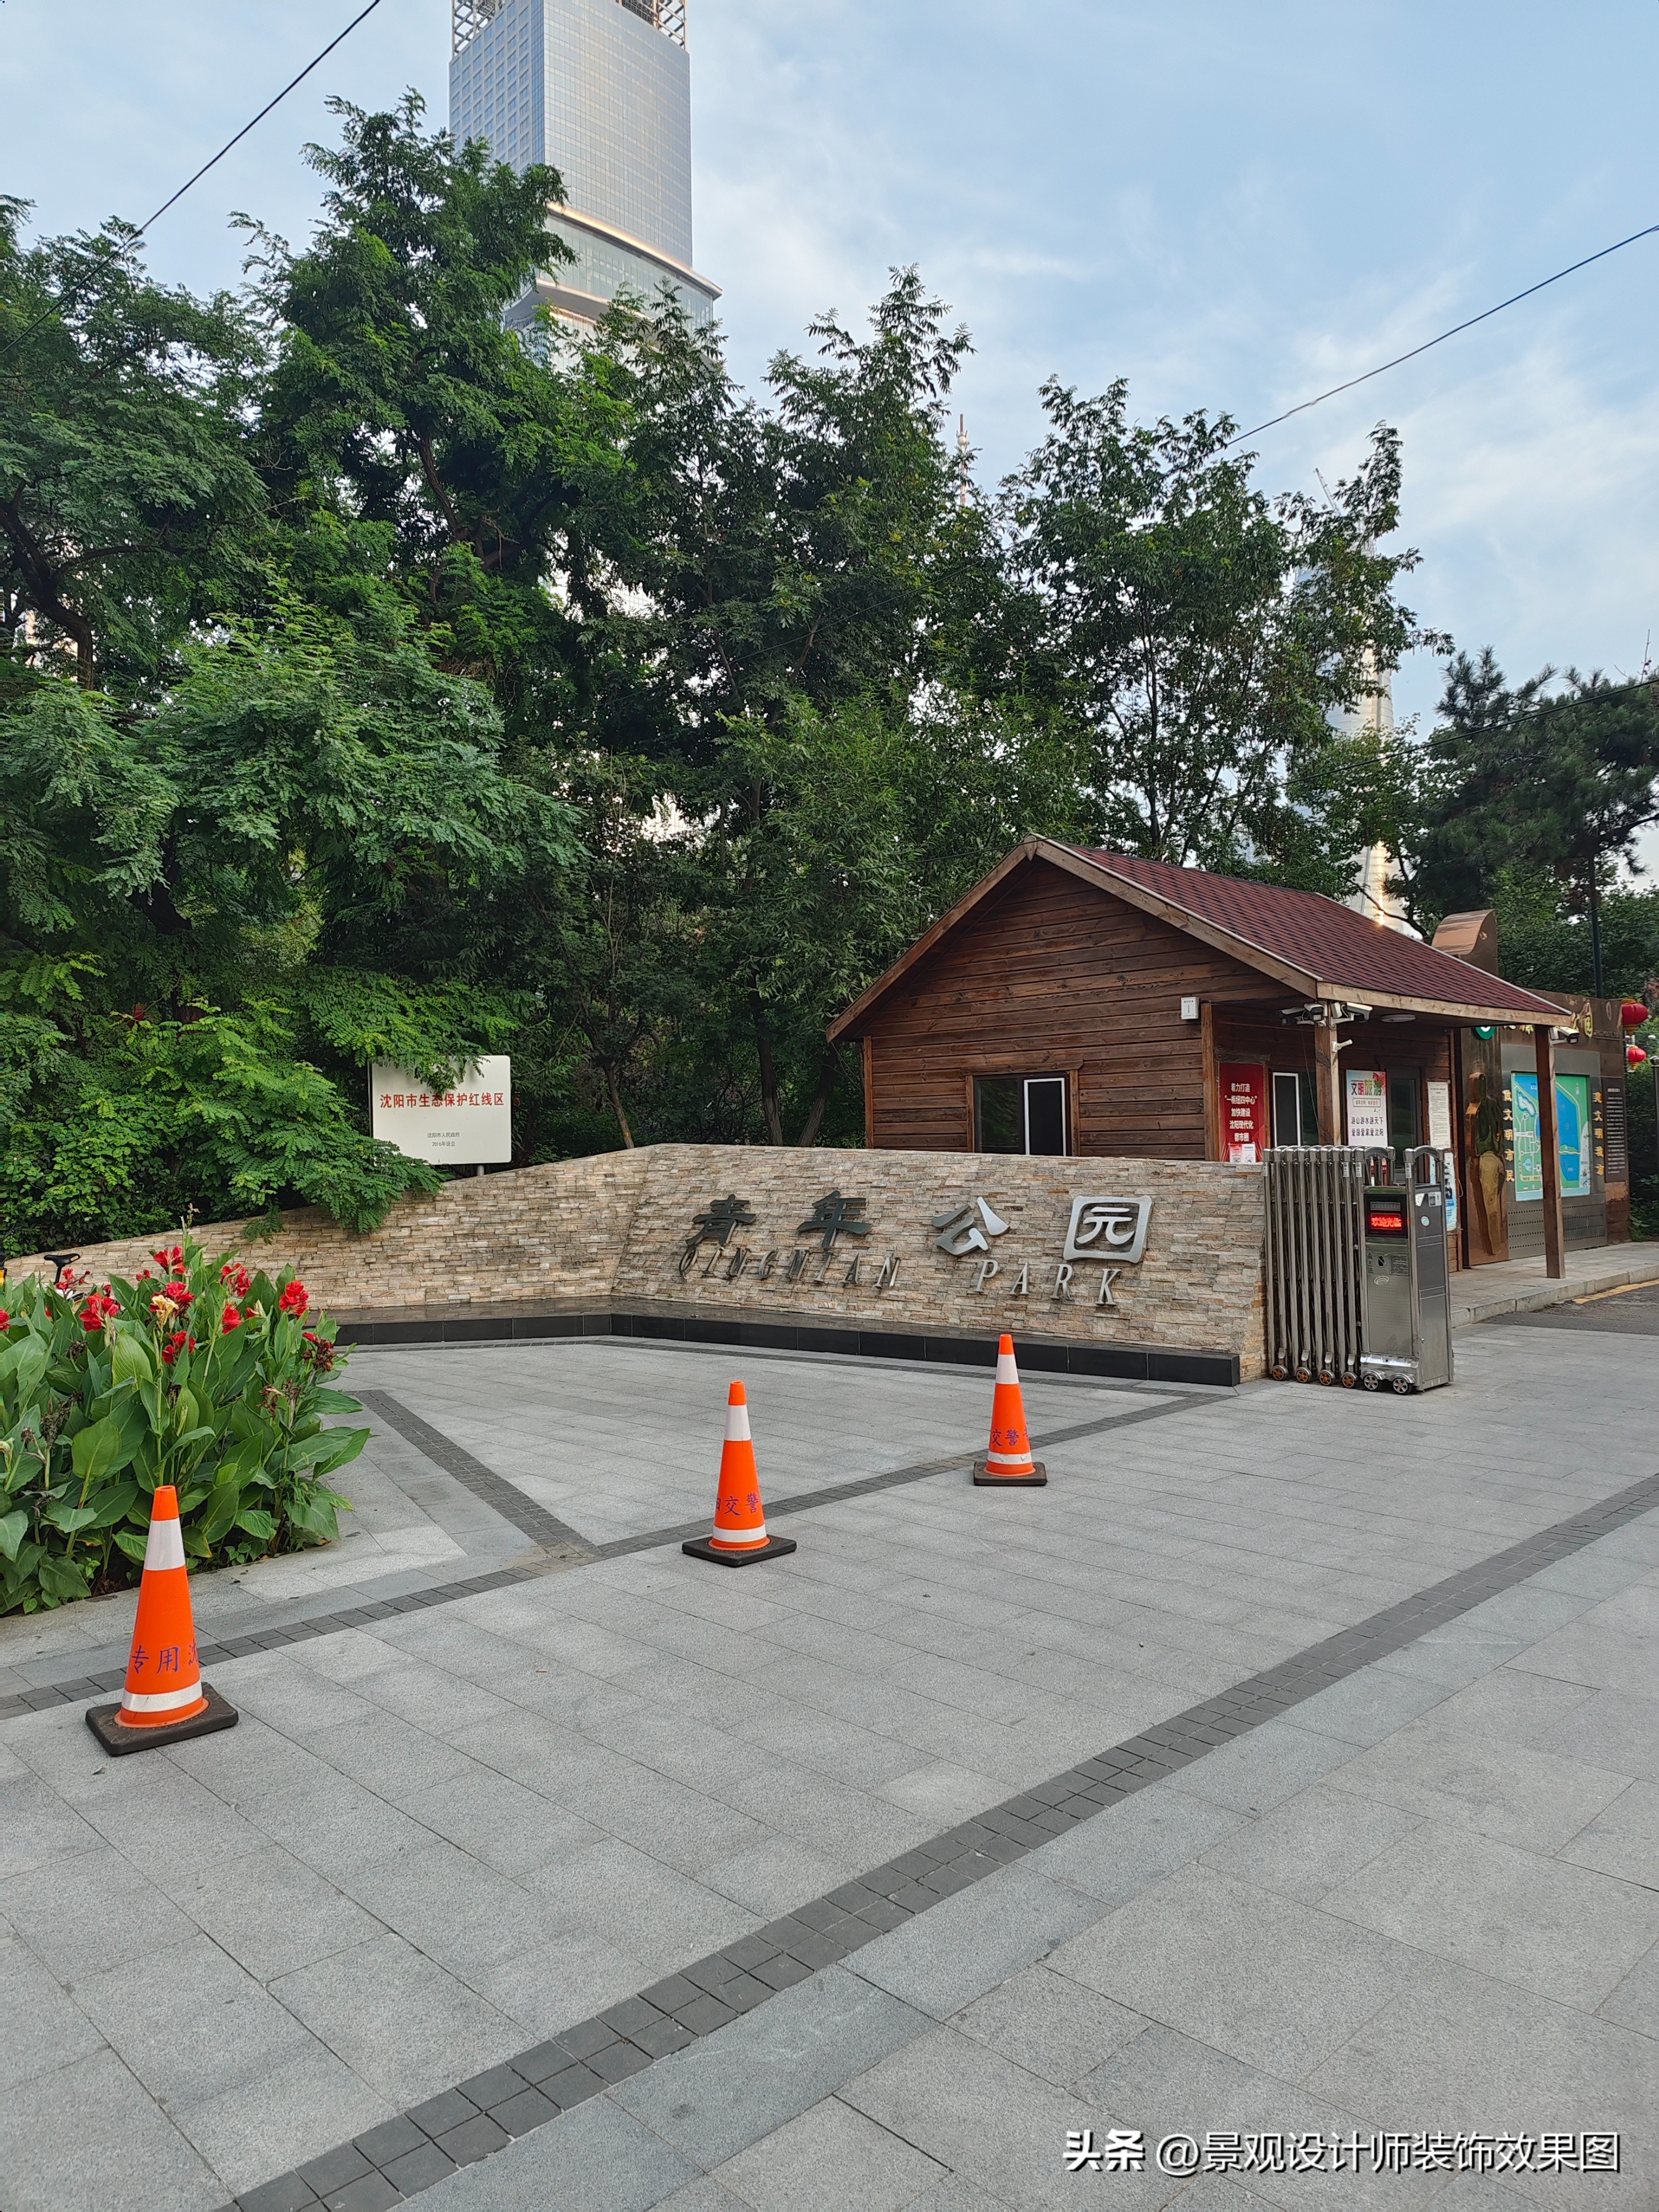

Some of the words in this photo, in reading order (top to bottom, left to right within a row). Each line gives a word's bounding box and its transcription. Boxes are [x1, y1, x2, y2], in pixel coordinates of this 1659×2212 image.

[1231, 1083, 1251, 1092] 着力打造
[1351, 1079, 1382, 1096] 文明旅游
[380, 1092, 505, 1108] 沈阳市生态保护红线区
[1231, 1108, 1251, 1117] 加快建设
[1229, 1120, 1254, 1130] 沈阳现代化
[685, 1190, 1154, 1264] 青年公园
[677, 1246, 902, 1289] QINGNIAN
[973, 1259, 1122, 1307] PARK
